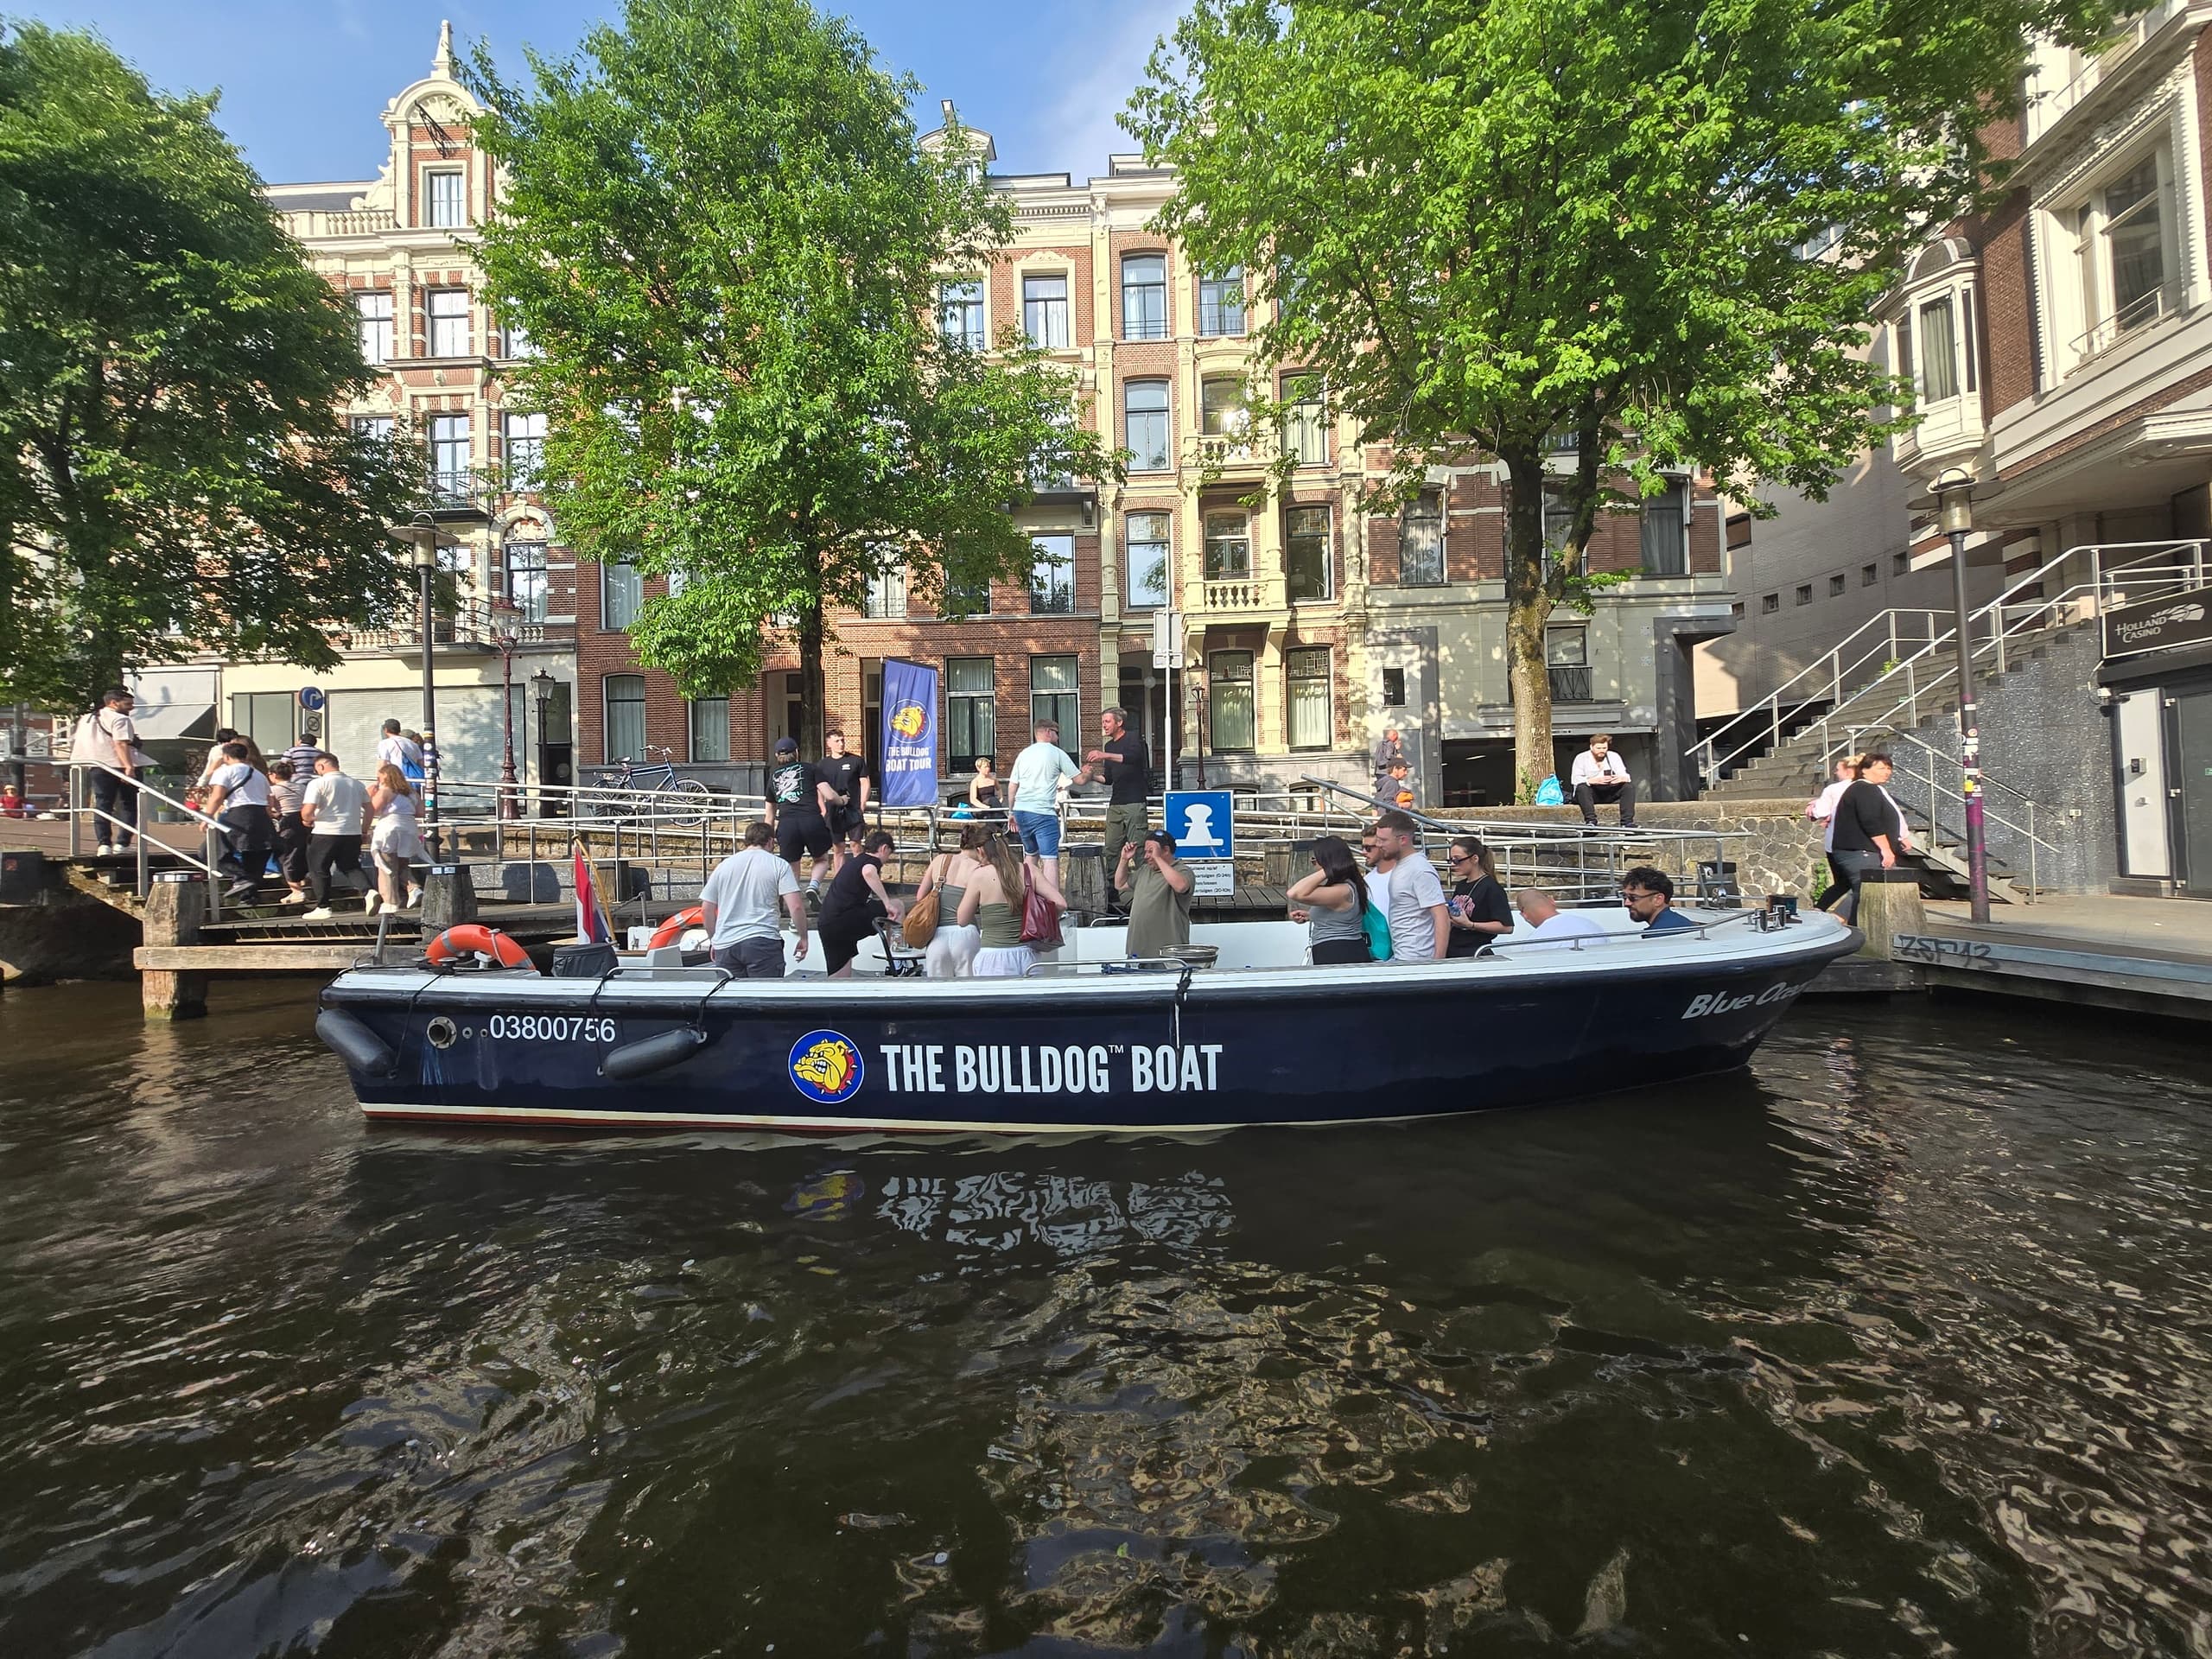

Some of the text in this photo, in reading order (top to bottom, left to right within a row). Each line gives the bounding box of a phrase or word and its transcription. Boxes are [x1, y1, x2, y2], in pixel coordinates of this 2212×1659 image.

[2115, 616, 2167, 636] HOLLAND
[2122, 626, 2161, 643] CASINO
[888, 746, 900, 757] THE
[886, 757, 931, 772] BOAT TOUR
[1681, 990, 1755, 1020] Blue
[489, 1014, 616, 1042] 03800756
[880, 1044, 946, 1092] THE
[1131, 1044, 1224, 1092] BOAT
